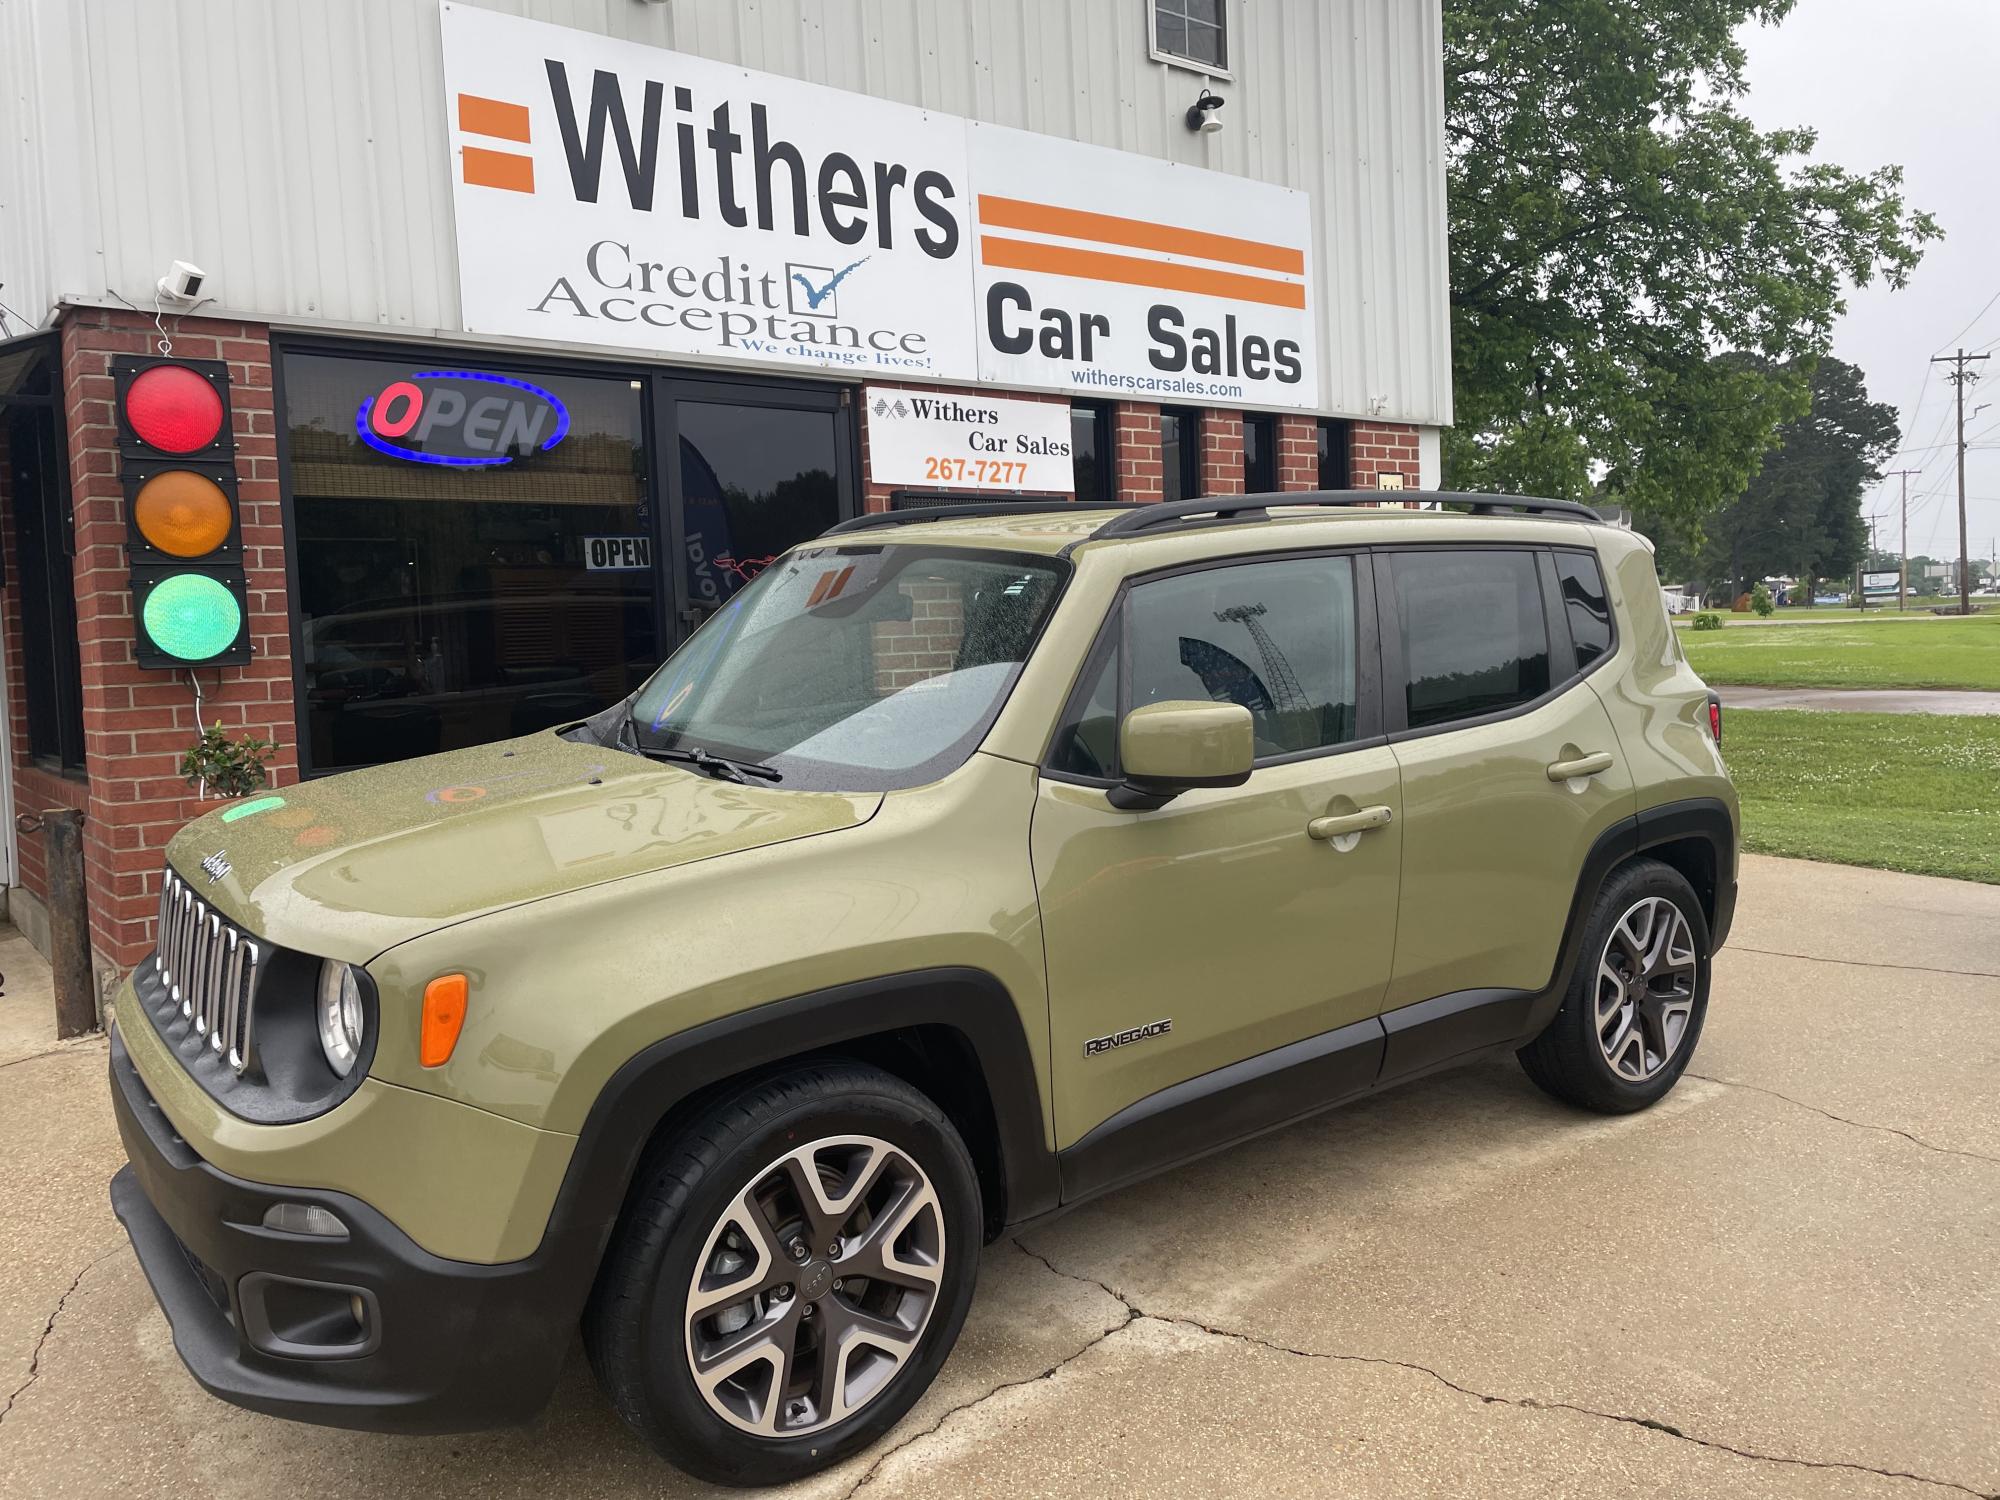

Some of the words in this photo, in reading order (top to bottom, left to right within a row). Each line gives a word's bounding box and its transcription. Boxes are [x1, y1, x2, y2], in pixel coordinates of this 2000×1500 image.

[543, 58, 959, 260] Withers
[586, 240, 781, 309] Credit
[527, 276, 927, 355] Acceptance
[986, 281, 1110, 362] Car
[1147, 304, 1302, 384] Sales
[740, 338, 778, 353] We
[786, 345, 868, 365] change
[876, 352, 932, 369] lives!
[1071, 367, 1243, 398] witherscarsales.com
[372, 381, 549, 457] OPEN
[910, 398, 999, 425] Withers
[968, 431, 1008, 453] Car
[1016, 435, 1071, 457] Sales
[925, 456, 1028, 484] 267-7277
[591, 539, 649, 568] OPEN
[1084, 1018, 1172, 1057] RENEGADE
